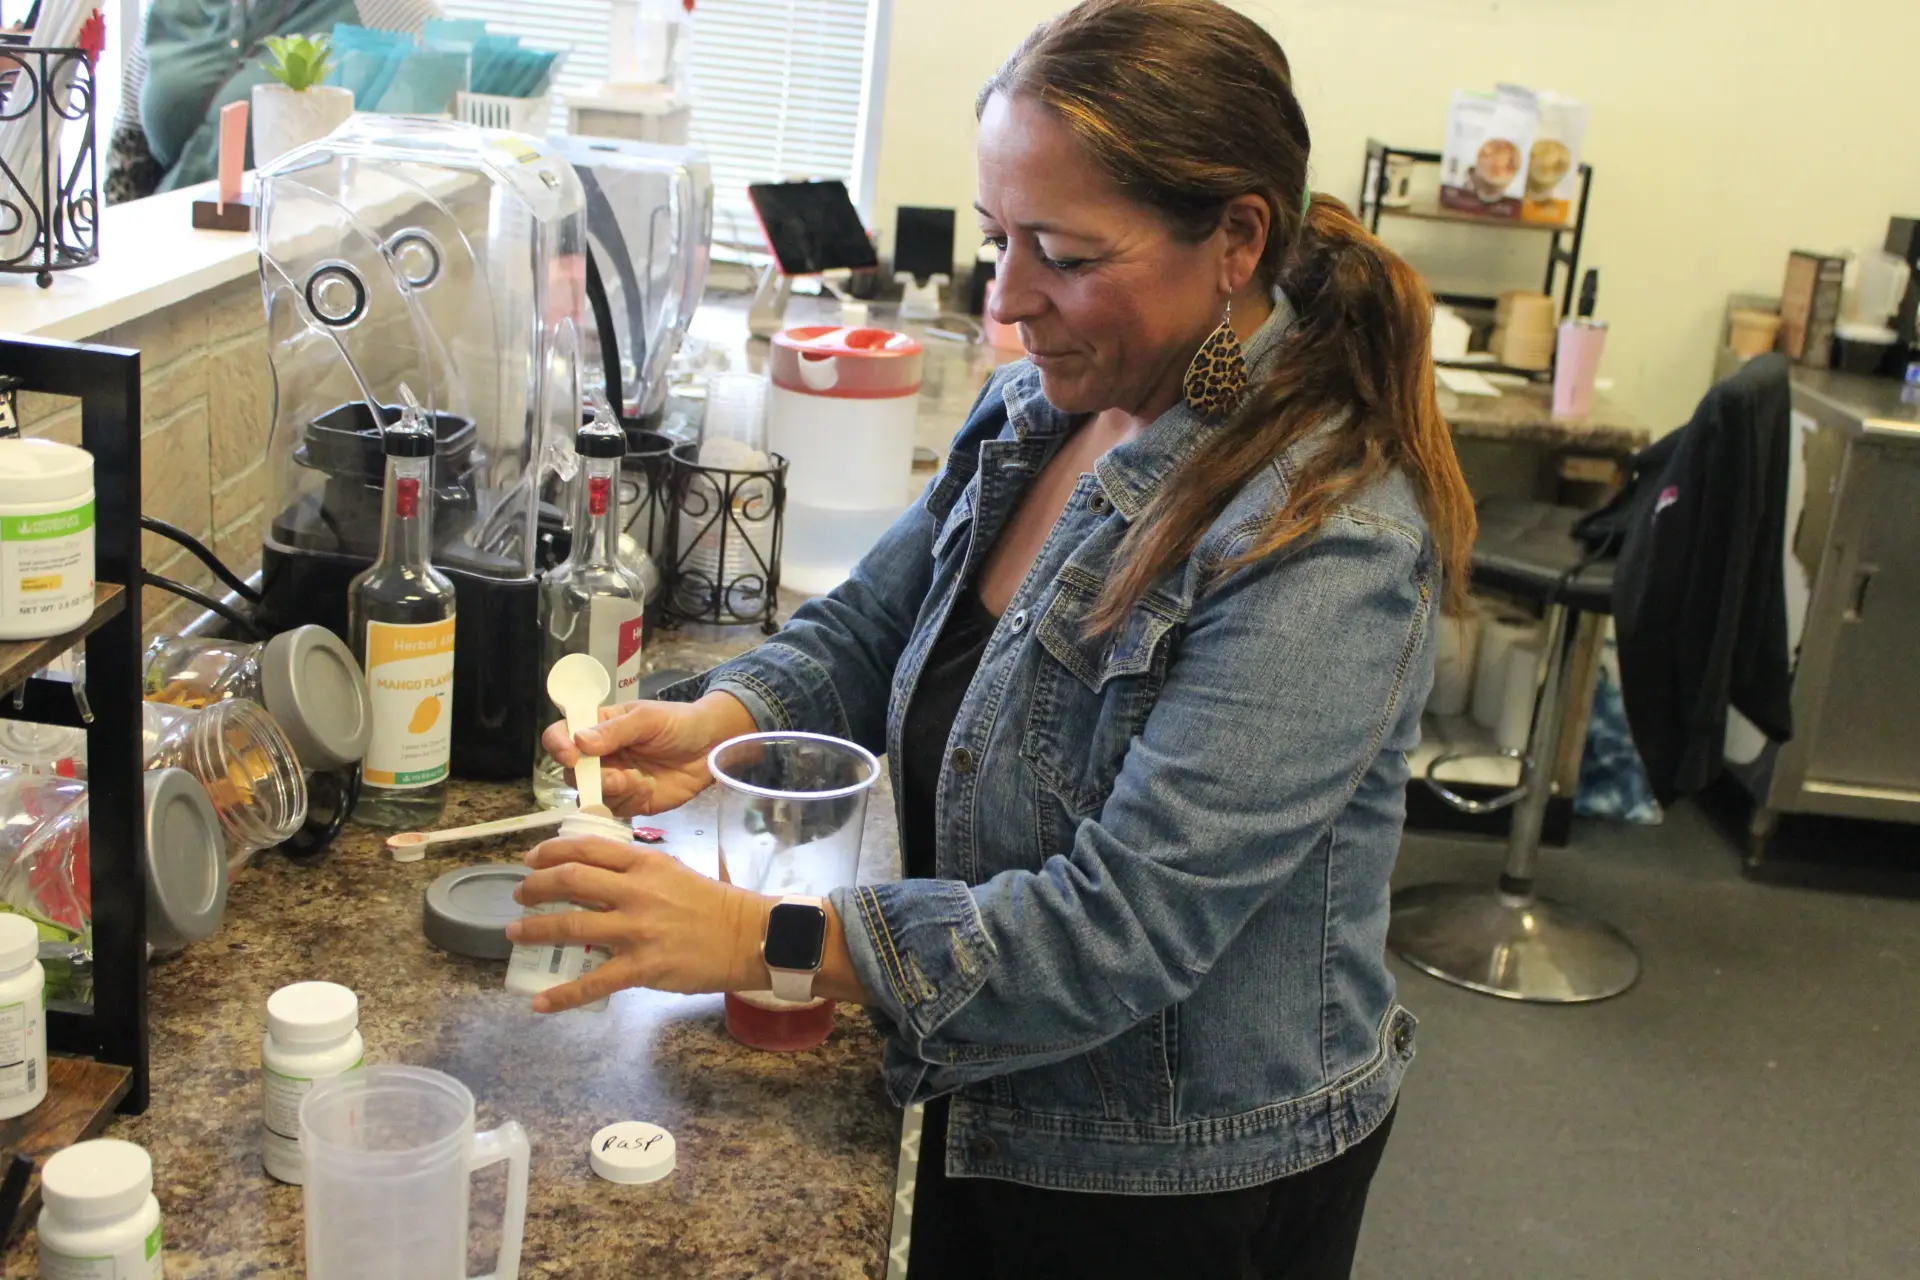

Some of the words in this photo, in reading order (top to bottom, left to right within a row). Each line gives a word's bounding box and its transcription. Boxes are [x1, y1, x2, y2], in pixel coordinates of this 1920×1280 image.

[19, 606, 37, 615] NET
[394, 637, 437, 651] Herbal
[377, 678, 422, 691] MANGO
